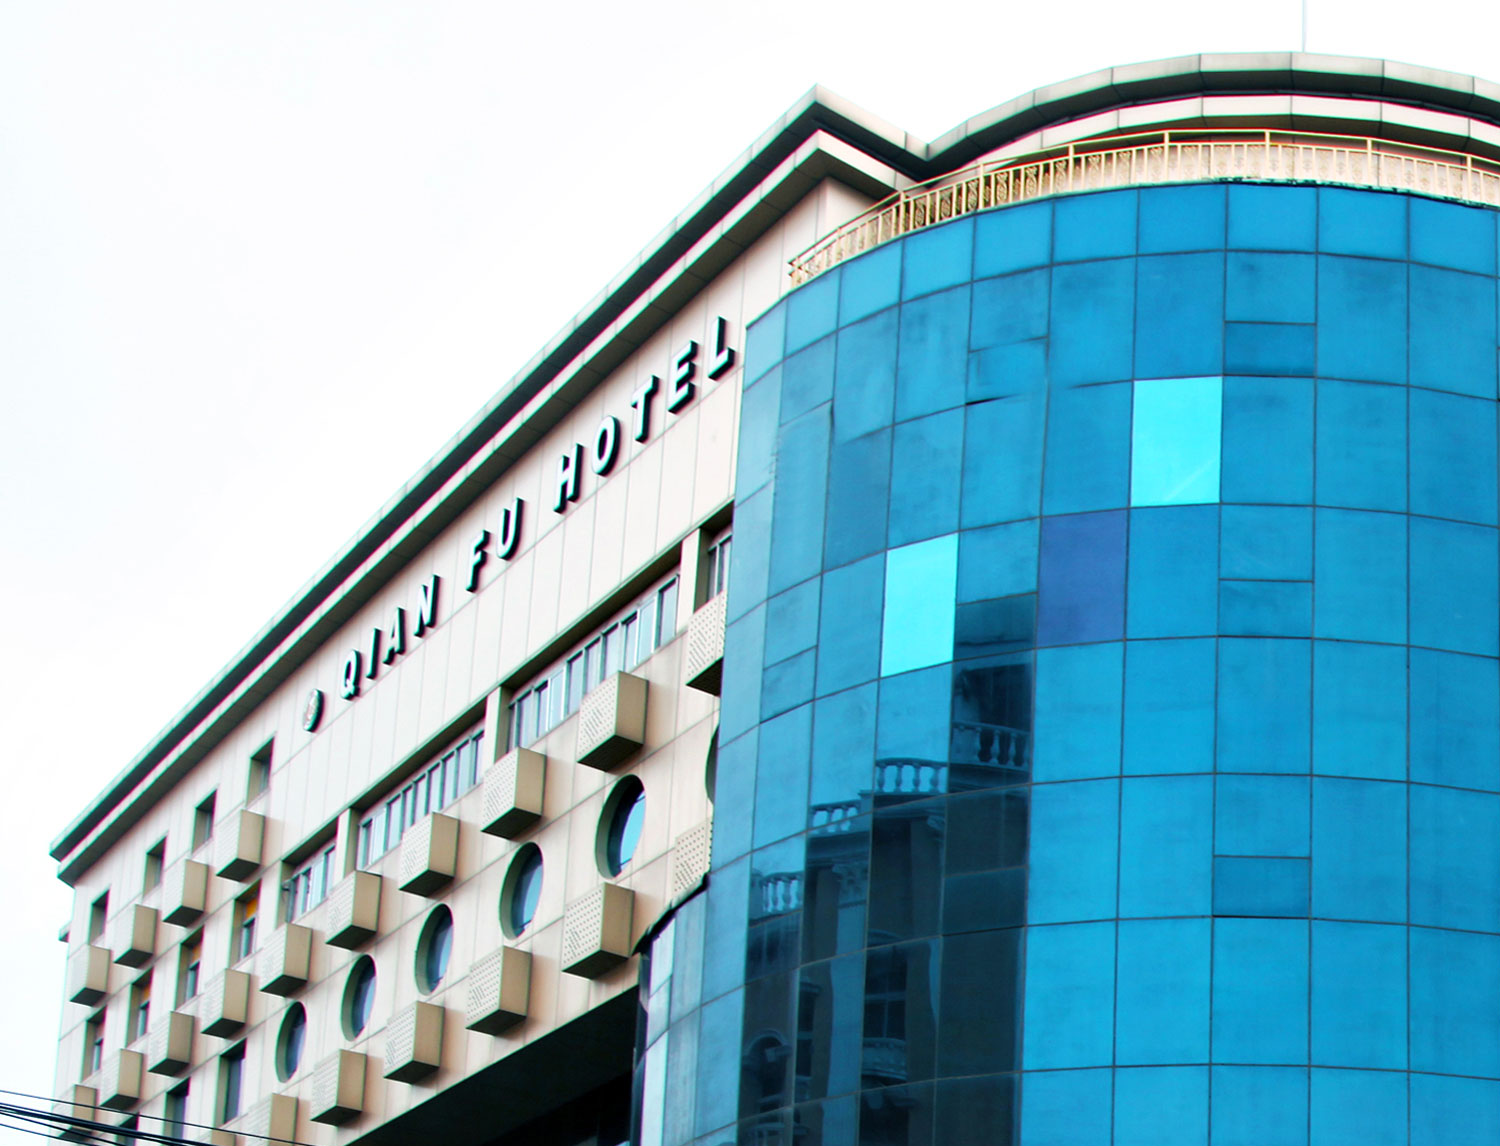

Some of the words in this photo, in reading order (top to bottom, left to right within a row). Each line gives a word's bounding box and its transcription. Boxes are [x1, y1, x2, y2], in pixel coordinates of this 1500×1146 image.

[340, 573, 441, 701] QIAN
[466, 497, 524, 593] FU
[553, 315, 737, 515] HOTEL
